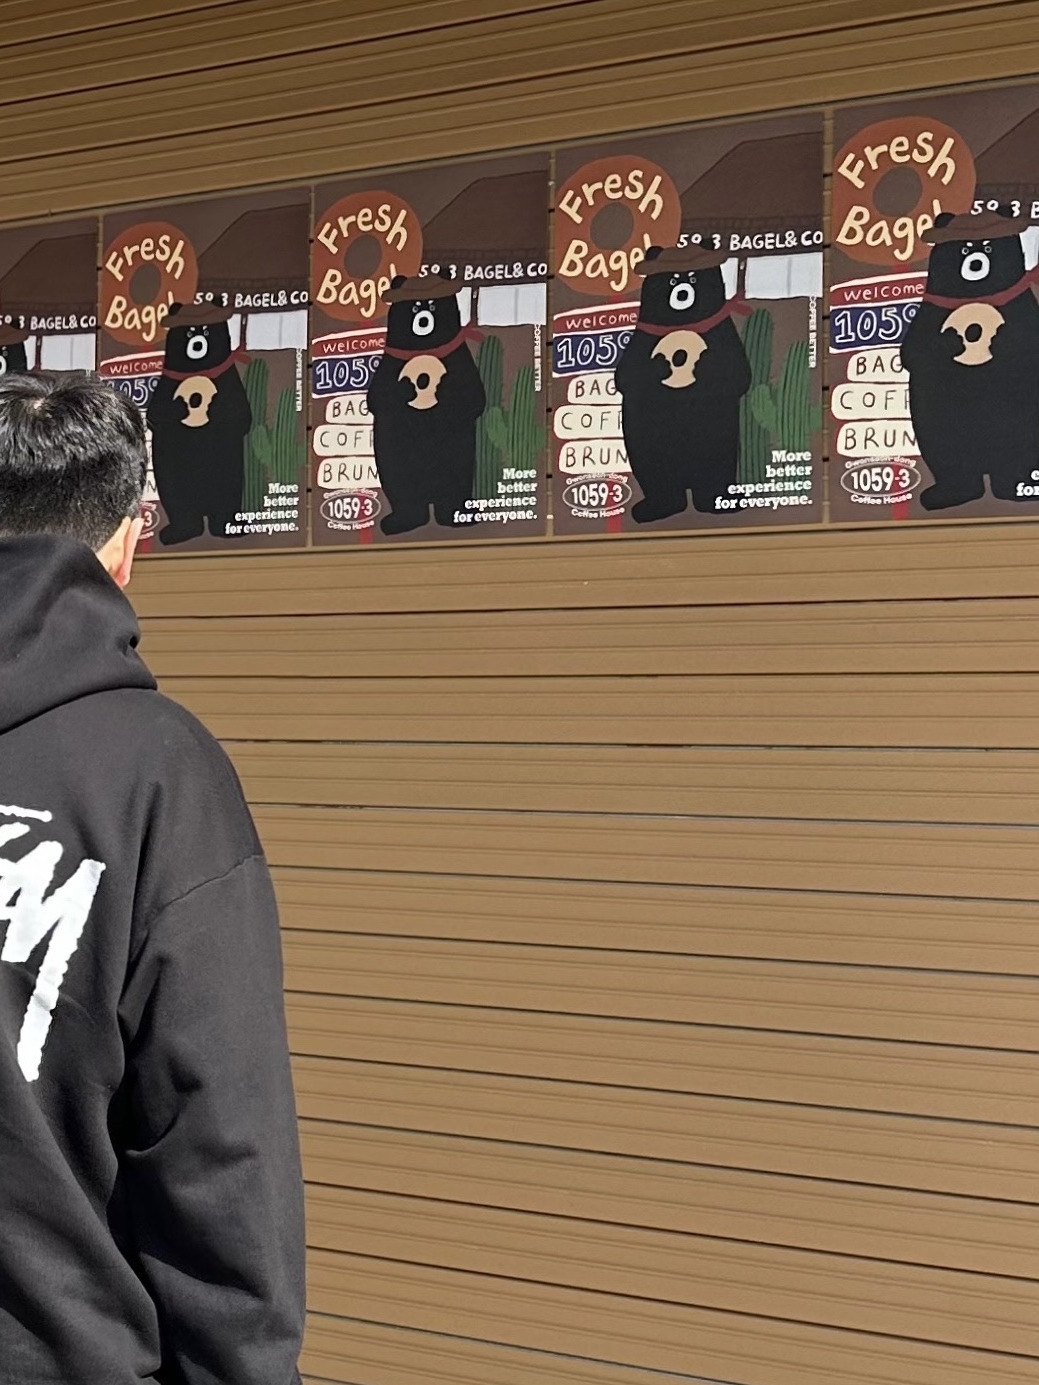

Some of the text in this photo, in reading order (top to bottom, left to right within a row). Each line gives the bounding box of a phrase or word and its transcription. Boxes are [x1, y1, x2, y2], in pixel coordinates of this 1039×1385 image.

[839, 132, 956, 189] Fresh
[559, 170, 663, 223] Fresh
[318, 204, 408, 253] Fresh
[106, 235, 185, 281] Fresh
[844, 284, 925, 301] welcome
[566, 313, 637, 329] welcome
[323, 338, 385, 353] welcome
[109, 361, 163, 374] welcome
[772, 450, 811, 462] More
[503, 468, 537, 480] More
[766, 465, 812, 477] better
[728, 479, 812, 496] experience
[850, 467, 912, 493] 1059-3
[268, 483, 299, 494] More
[497, 482, 537, 494] better
[570, 483, 624, 507] 1059-3
[263, 496, 299, 506] better
[327, 497, 374, 520] 1059-3
[464, 495, 537, 511] experience
[715, 495, 812, 509] for everyone.
[234, 508, 299, 523] experience
[454, 510, 537, 523] for everyone.
[225, 523, 300, 535] for everyone.
